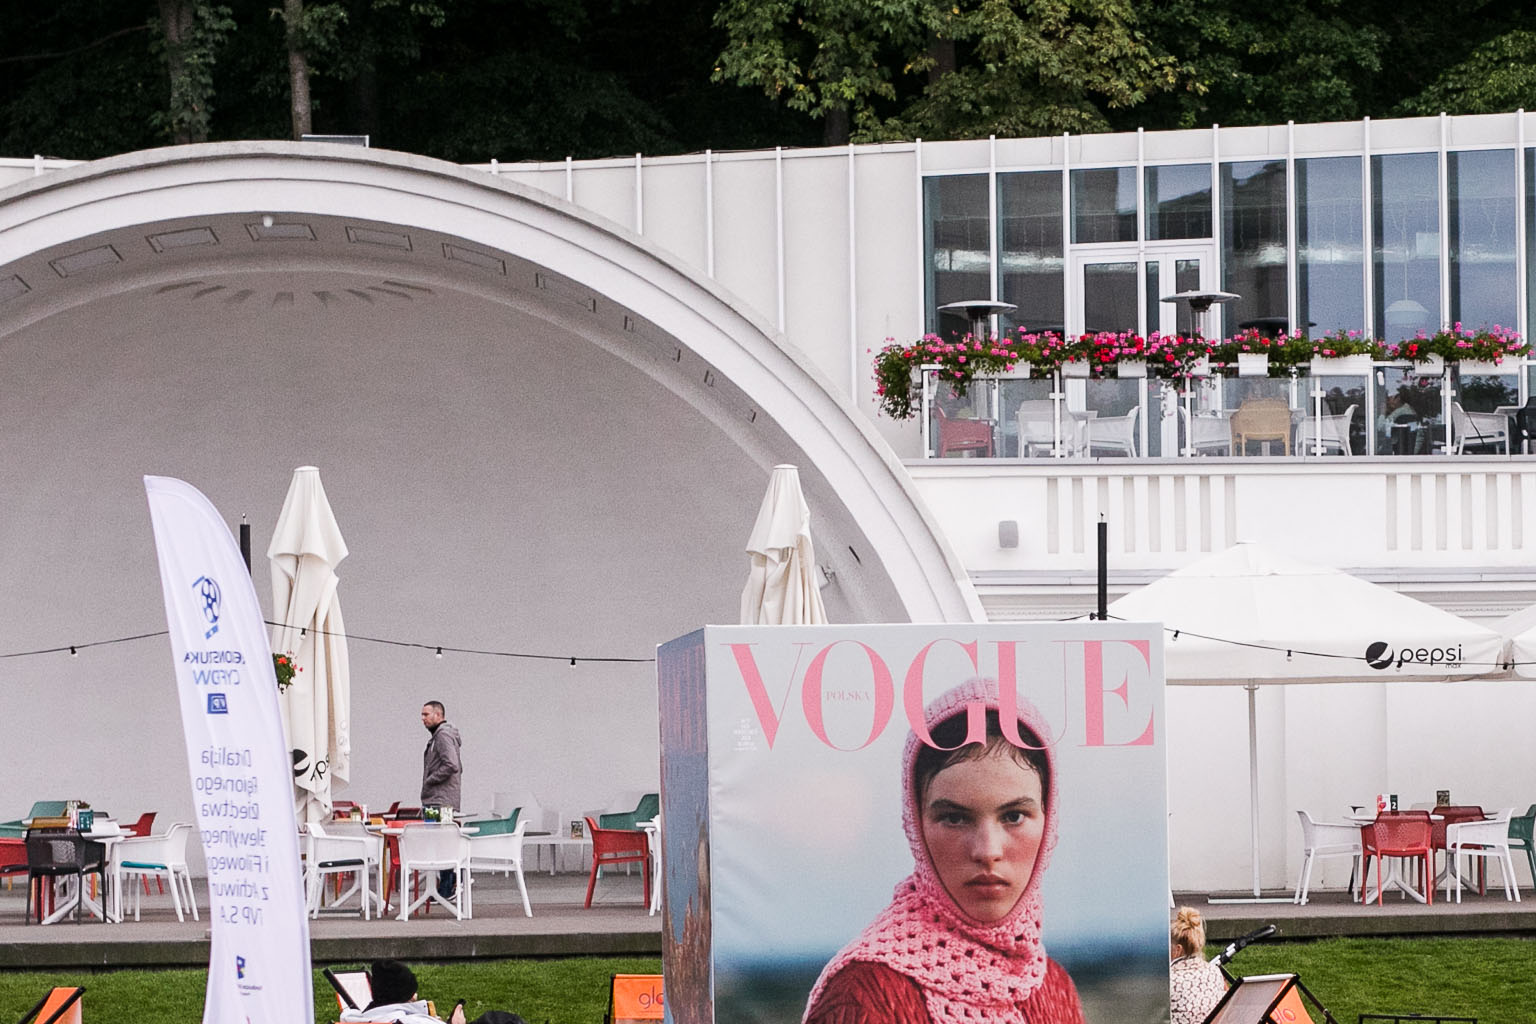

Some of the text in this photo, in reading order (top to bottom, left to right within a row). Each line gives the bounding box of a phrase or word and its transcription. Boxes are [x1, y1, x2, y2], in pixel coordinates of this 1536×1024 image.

[1400, 644, 1462, 667] pepsi
[719, 638, 1155, 752] VOGUE
[825, 689, 870, 702] POLSKA
